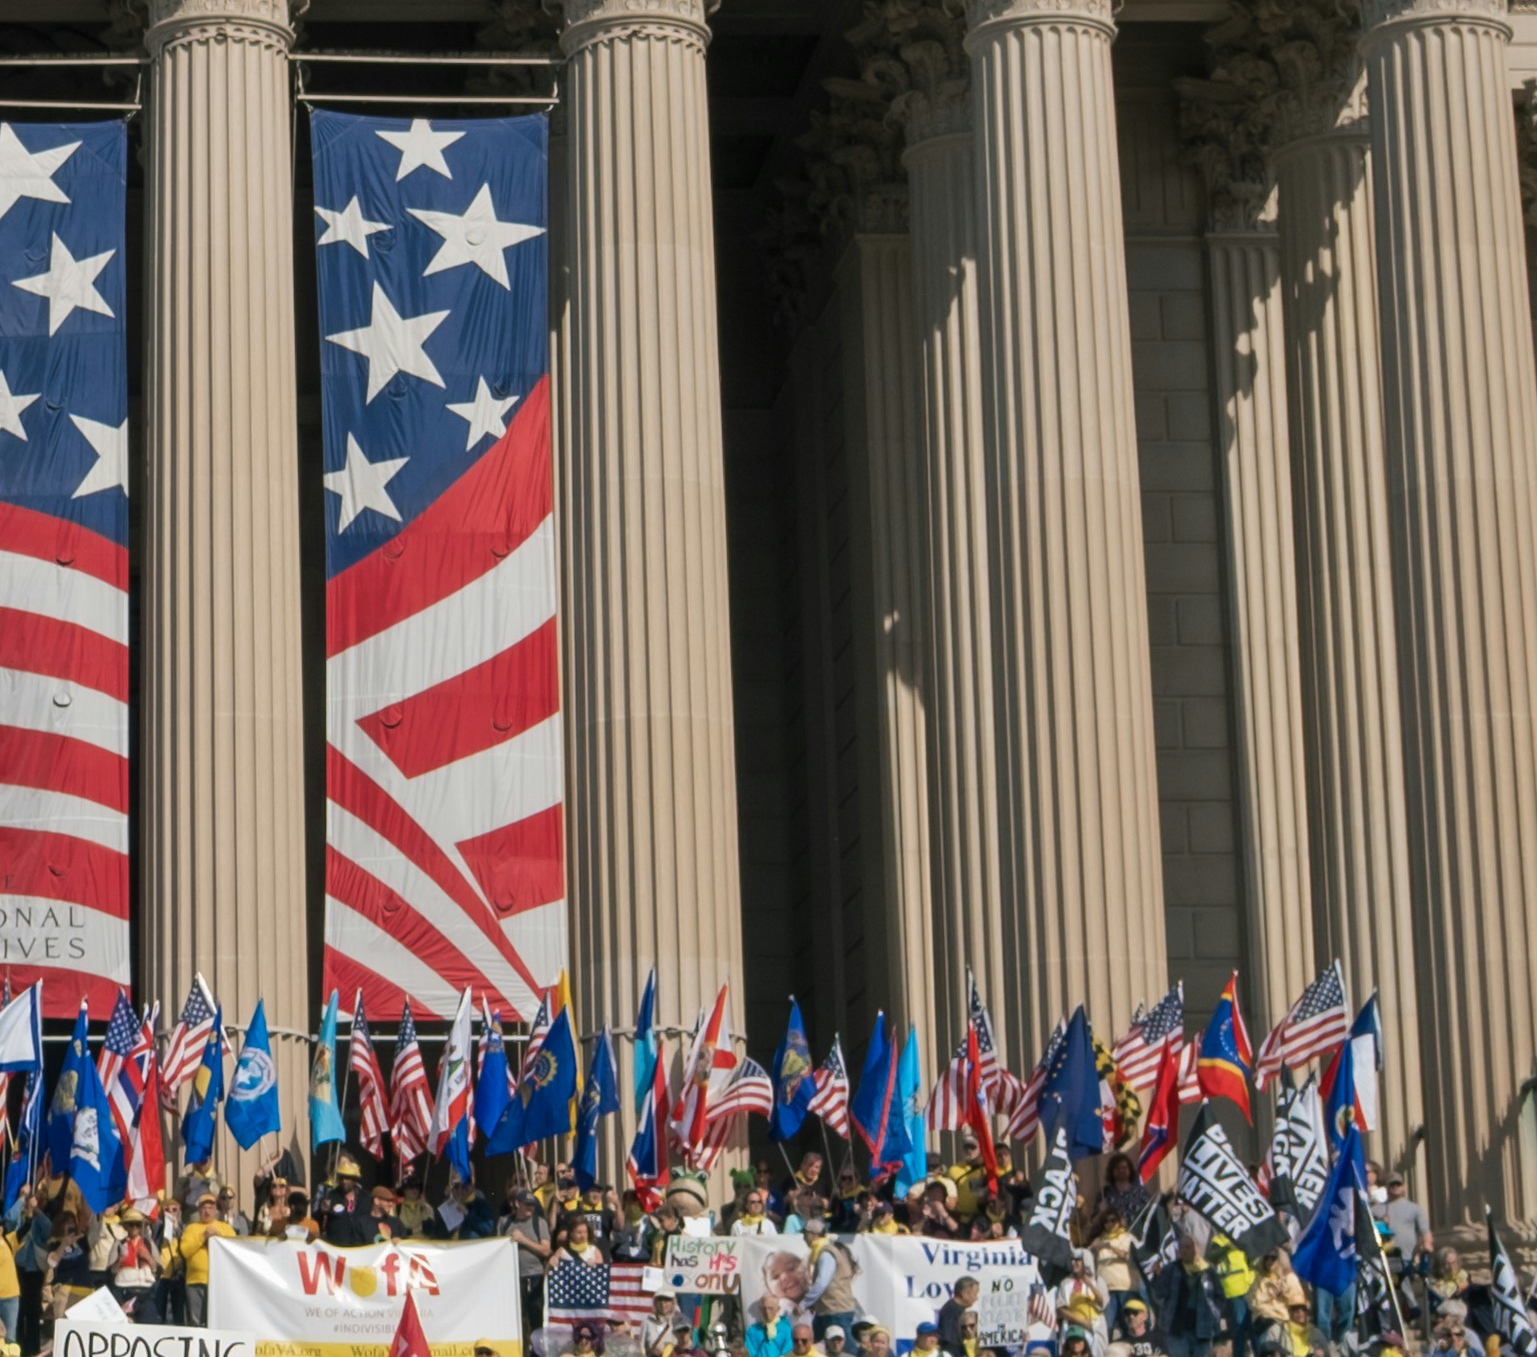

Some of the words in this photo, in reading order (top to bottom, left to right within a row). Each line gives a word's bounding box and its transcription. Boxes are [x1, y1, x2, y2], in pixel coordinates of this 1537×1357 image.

[1185, 1137, 1274, 1225] LIVES
[670, 1238, 736, 1259] History
[922, 1243, 1032, 1269] Virginia
[671, 1252, 699, 1268] has
[993, 1279, 1013, 1292] NO
[305, 1308, 322, 1316] WE
[325, 1308, 340, 1316] OF
[333, 1324, 397, 1334] #INDIVISIBL
[256, 1343, 322, 1357] ofaVA.org
